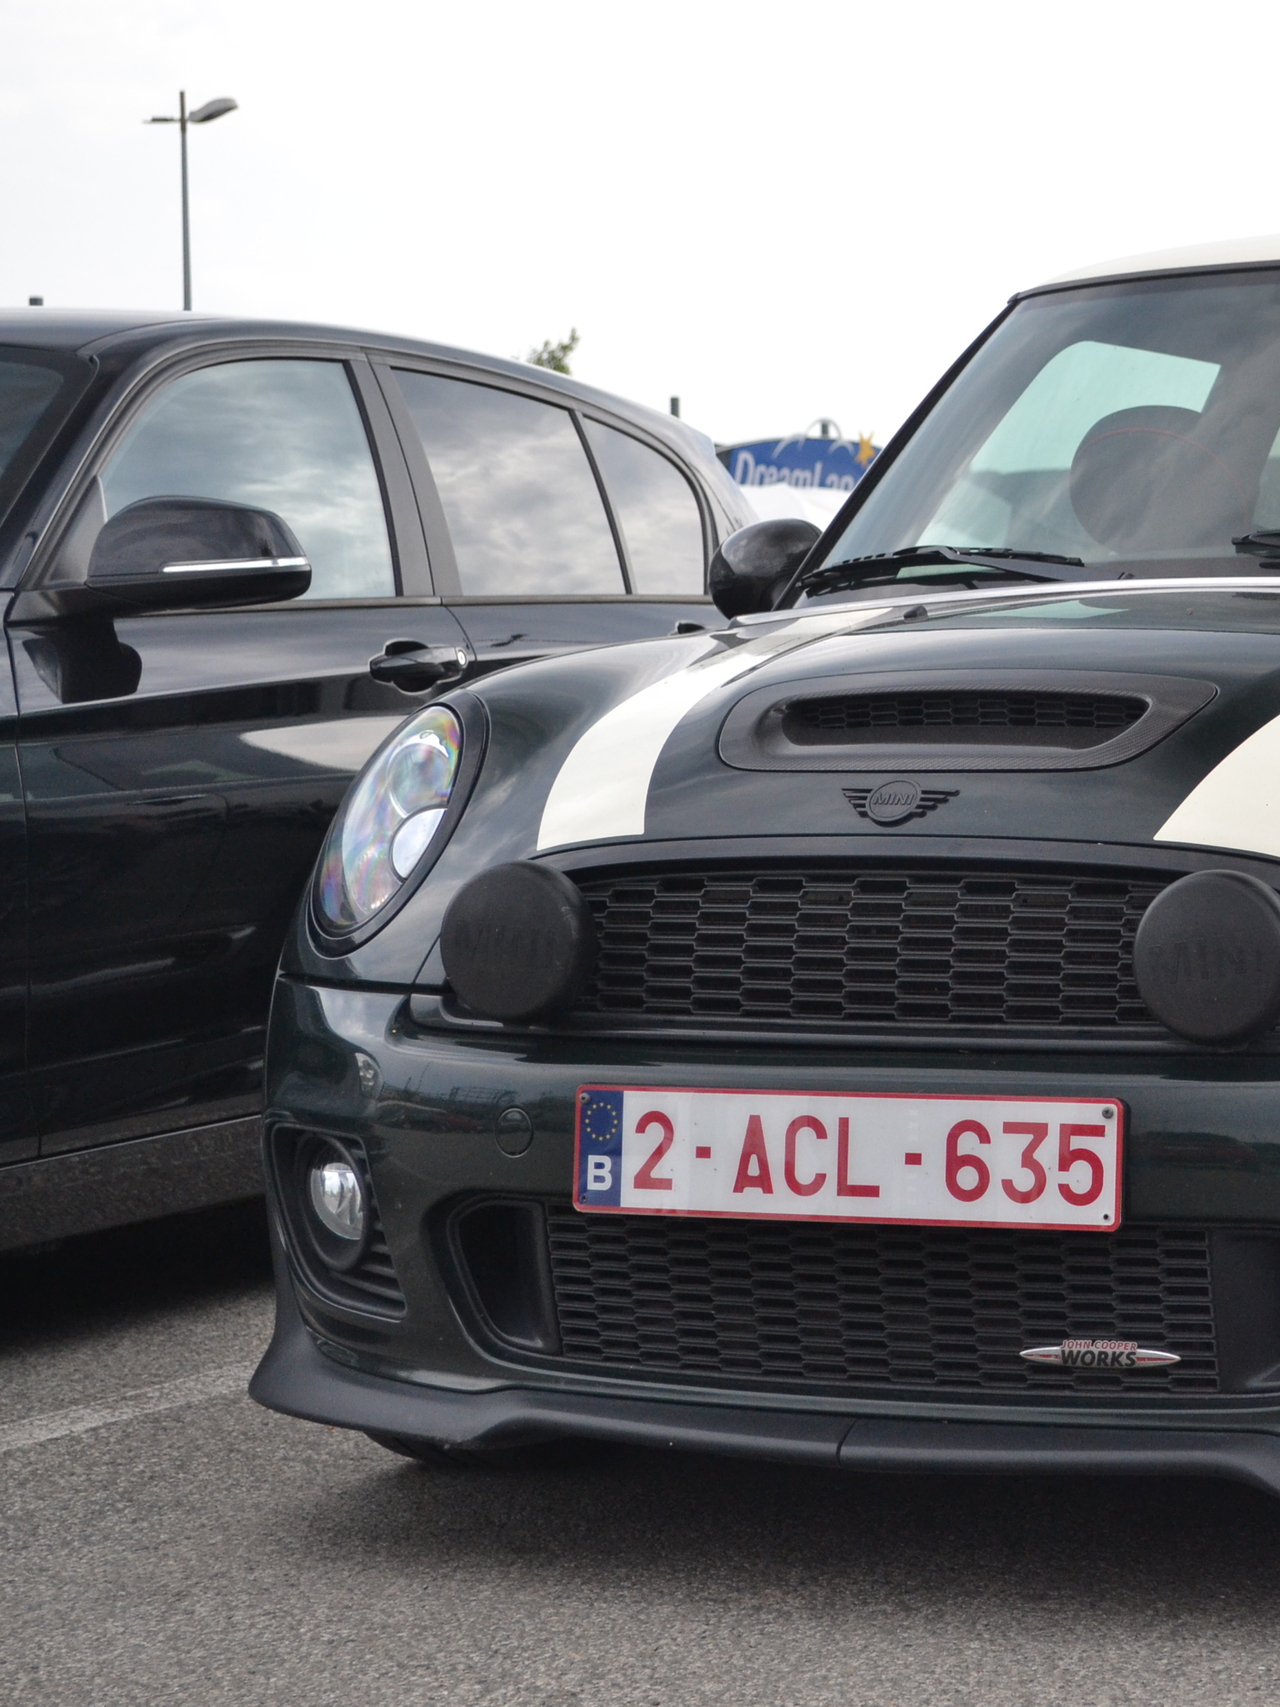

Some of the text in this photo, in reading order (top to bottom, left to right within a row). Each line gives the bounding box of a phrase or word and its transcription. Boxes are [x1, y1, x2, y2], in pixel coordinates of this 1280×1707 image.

[873, 793, 915, 806] MINI
[586, 1154, 612, 1191] B
[1060, 1339, 1137, 1351] JOHN COOPER
[1060, 1349, 1137, 1367] WORKS
